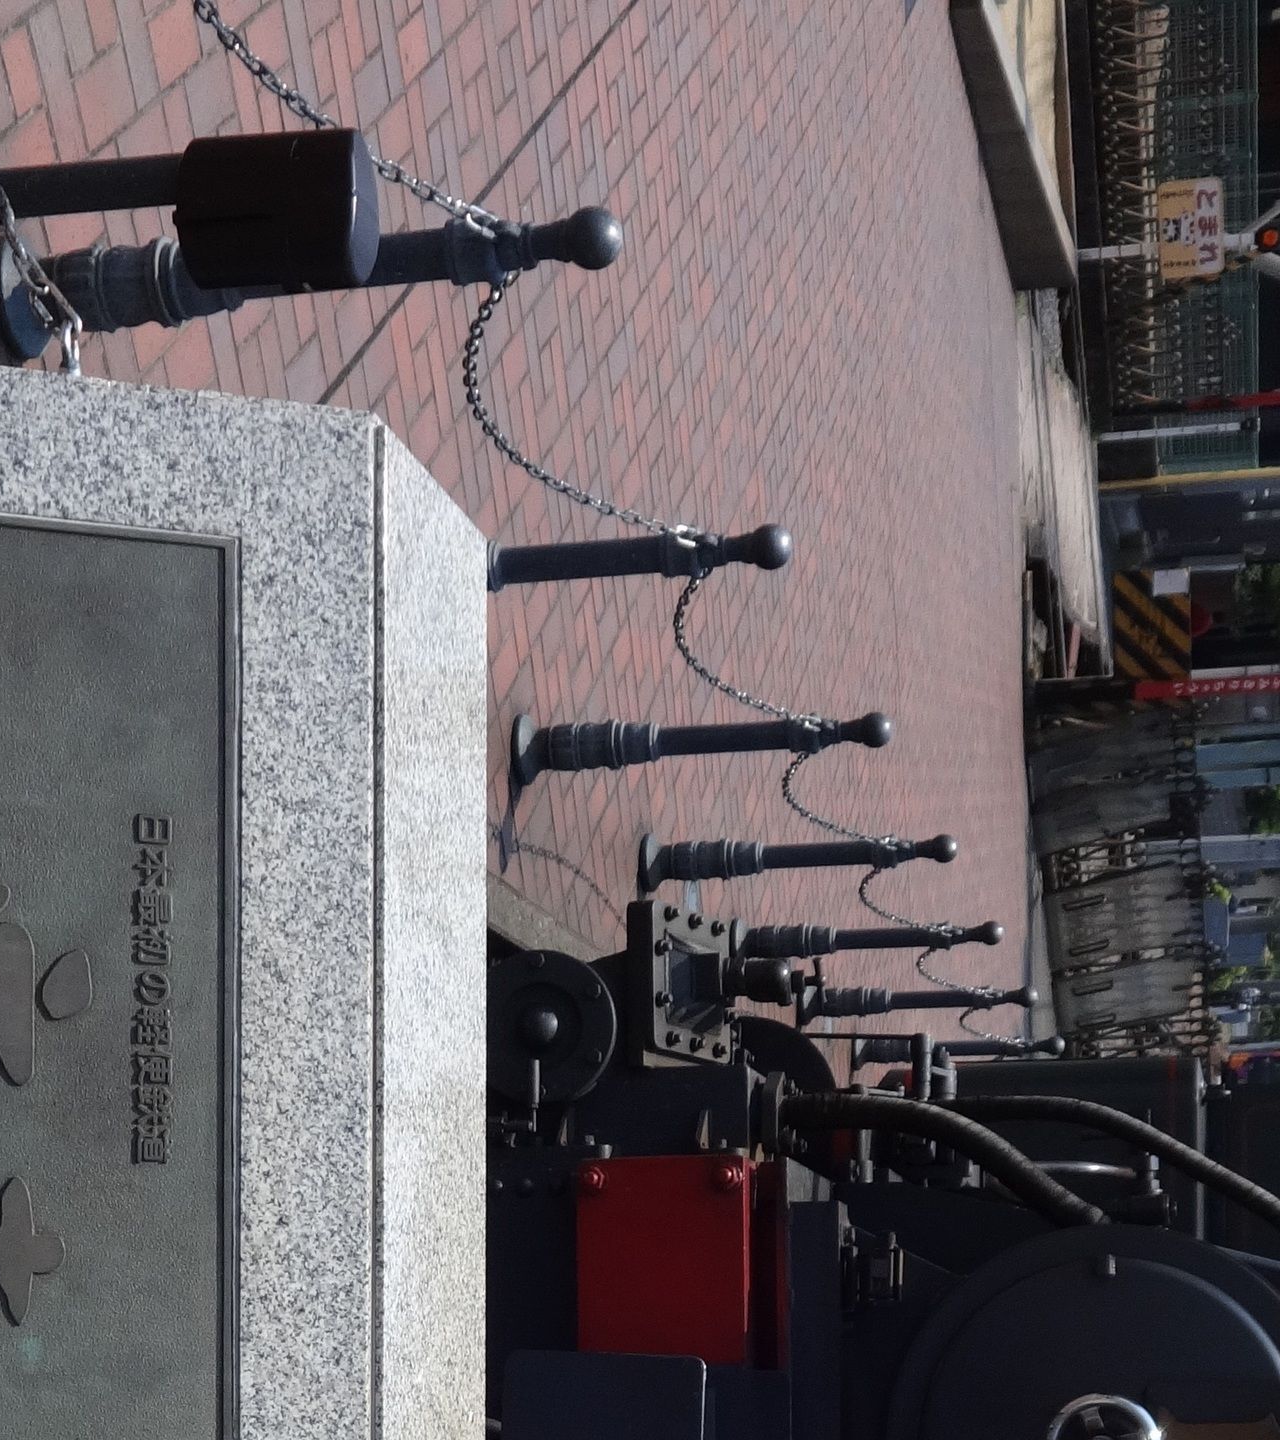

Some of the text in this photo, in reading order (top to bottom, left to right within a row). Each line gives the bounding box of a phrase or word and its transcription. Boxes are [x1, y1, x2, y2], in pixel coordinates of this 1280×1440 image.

[1196, 189, 1219, 265] とまれ
[132, 813, 174, 1165] 日本最初の軽便鉄道
